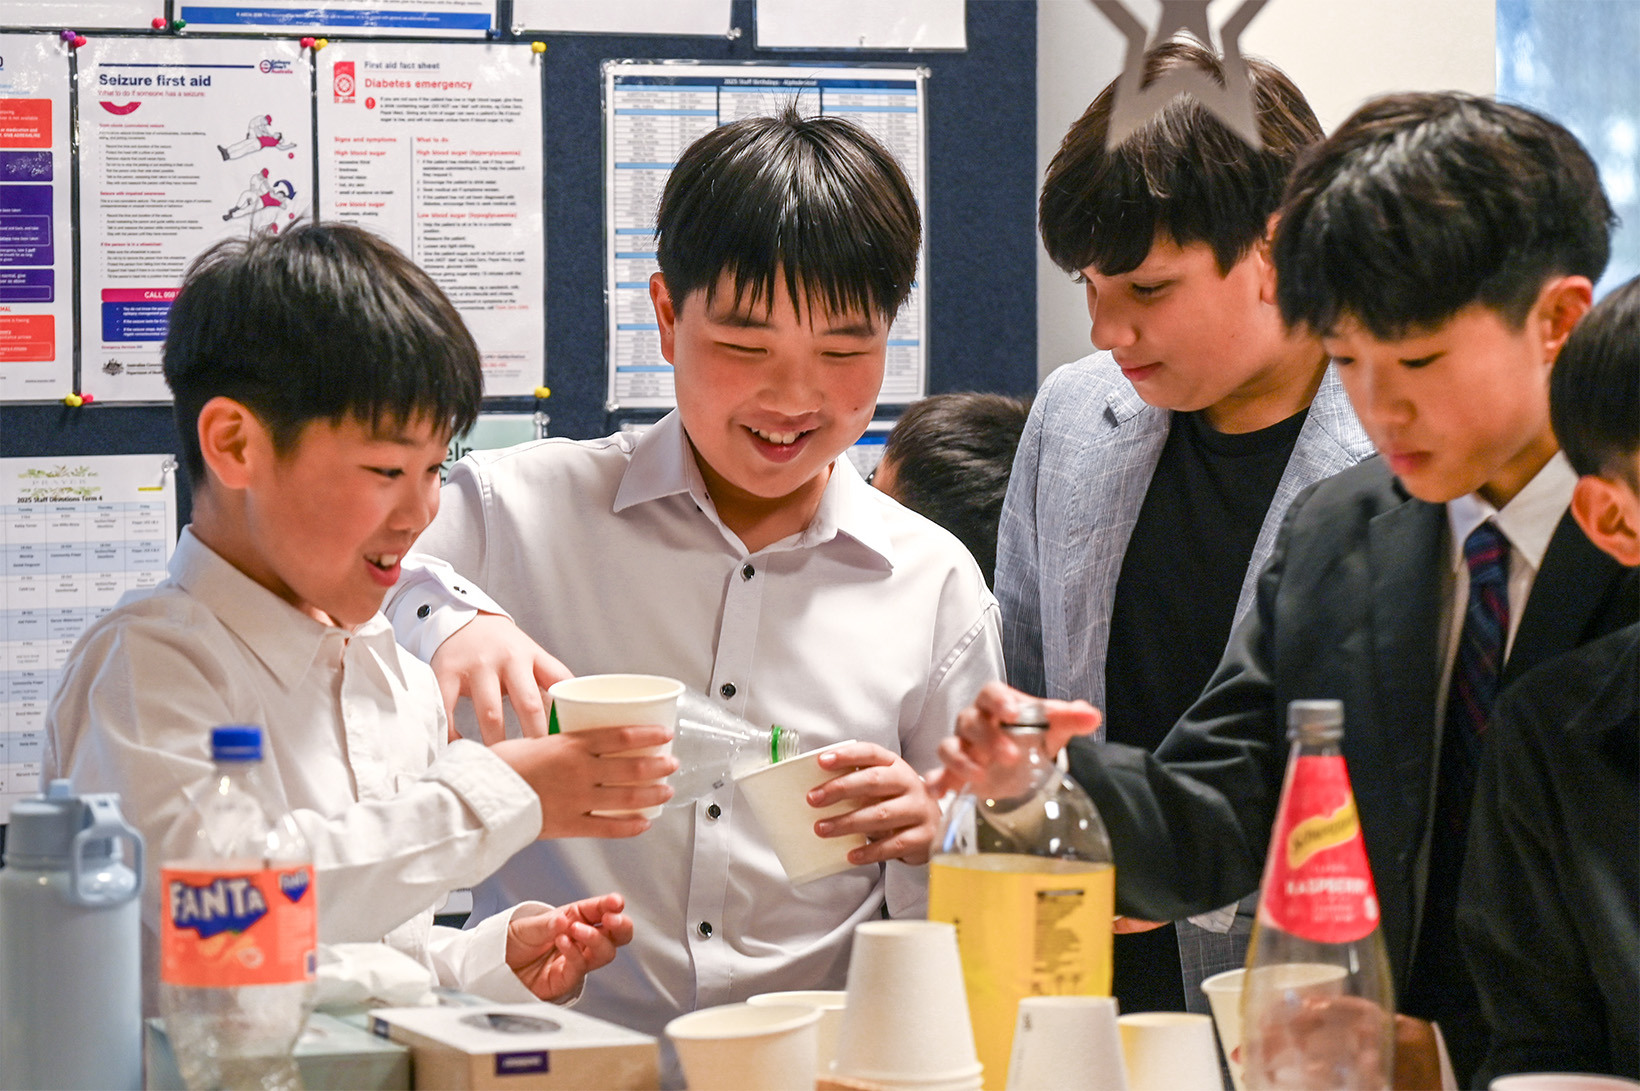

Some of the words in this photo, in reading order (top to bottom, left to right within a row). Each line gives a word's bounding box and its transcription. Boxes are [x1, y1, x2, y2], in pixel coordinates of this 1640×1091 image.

[99, 74, 152, 86] Seizure
[156, 74, 186, 86] first
[190, 74, 211, 86] aid
[364, 78, 411, 88] Diabetes
[415, 80, 472, 90] emergency
[170, 878, 265, 923] FANTA
